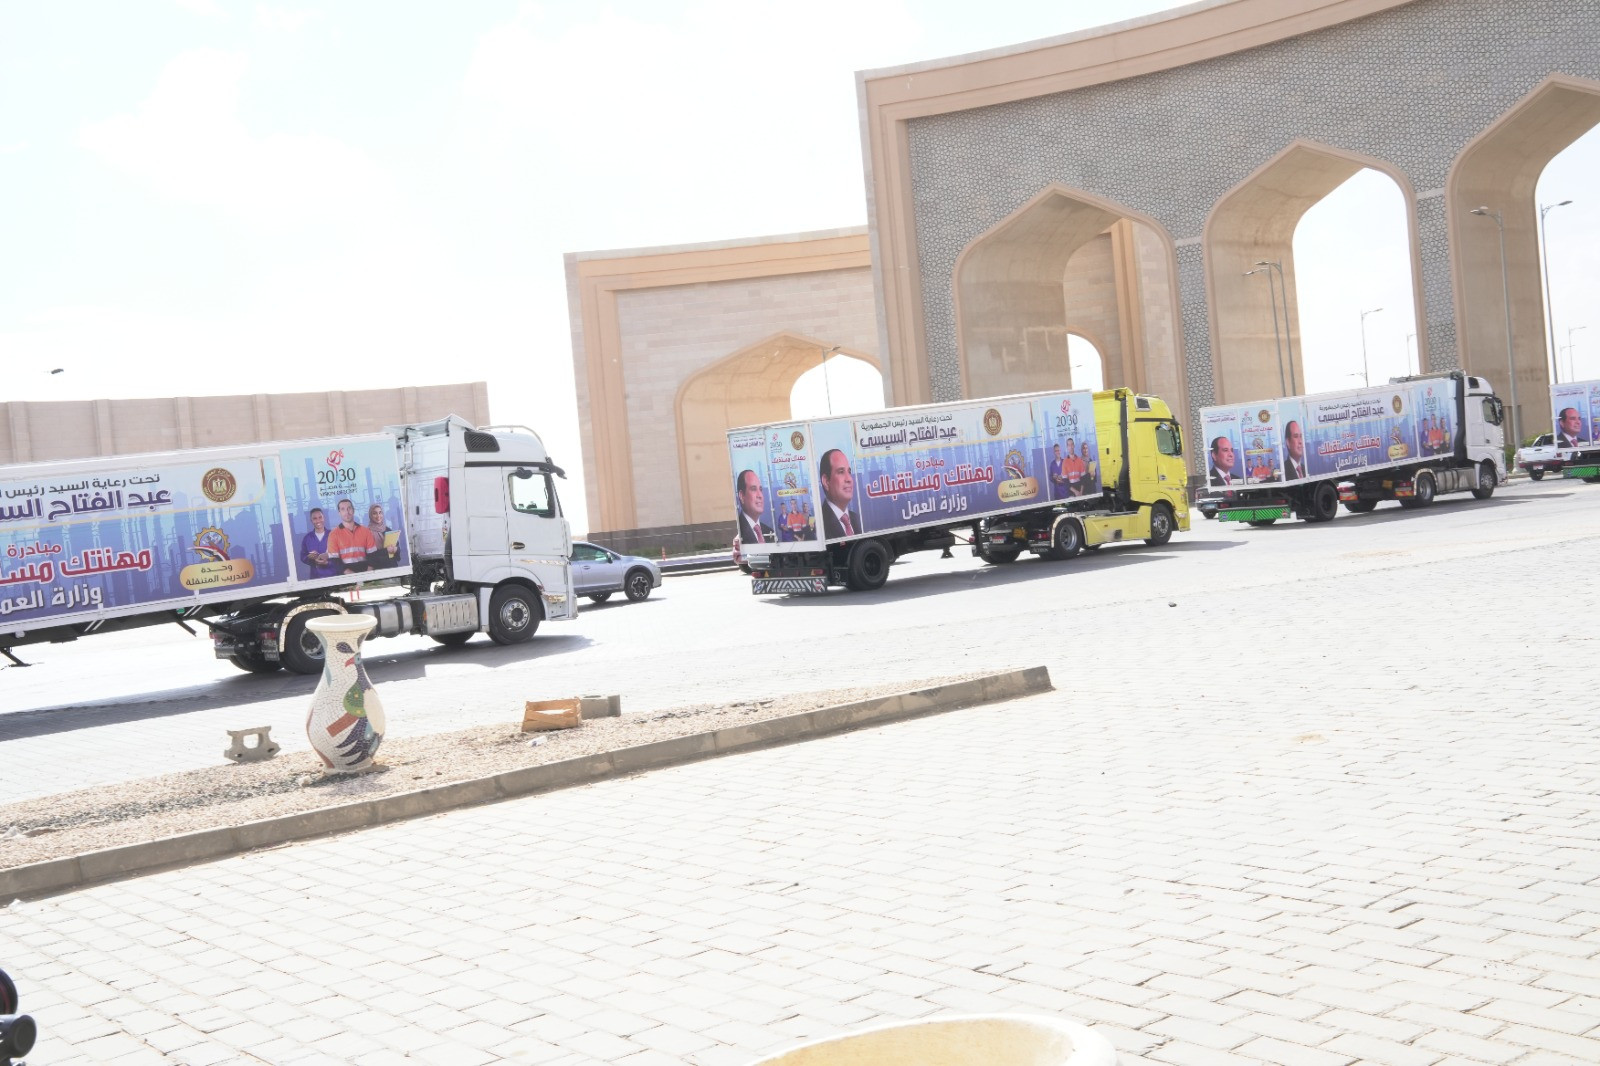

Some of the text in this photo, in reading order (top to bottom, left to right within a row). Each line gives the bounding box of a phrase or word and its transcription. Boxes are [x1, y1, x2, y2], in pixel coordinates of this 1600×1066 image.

[924, 415, 939, 424] رعاية
[1351, 406, 1372, 422] الفتاح
[1372, 406, 1384, 418] عبد
[860, 420, 892, 432] الجمهورية
[892, 418, 908, 428] رئيس
[908, 416, 924, 426] السيد
[1056, 414, 1078, 428] 2030
[908, 426, 938, 446] الفتاح
[940, 426, 957, 441] عبد
[1318, 435, 1381, 458] مهنتك مستقبلك
[915, 457, 945, 471] مبادرة
[1335, 453, 1368, 469] وزارة العمل
[92, 478, 126, 490] رعاية
[130, 474, 160, 485] تحت
[318, 468, 356, 484] 2030
[866, 463, 994, 500] مهنتك مستقبلك
[5, 484, 45, 499] رئيس
[49, 480, 90, 494] السيد
[48, 490, 122, 521] الفتاح
[128, 490, 172, 511] عبد
[902, 494, 968, 520] وزارة العمل
[7, 541, 62, 560] مبادرة
[60, 548, 153, 577] مهنتك
[186, 570, 250, 586] التدريب المتنقلة
[0, 583, 102, 614] وزارة العم
